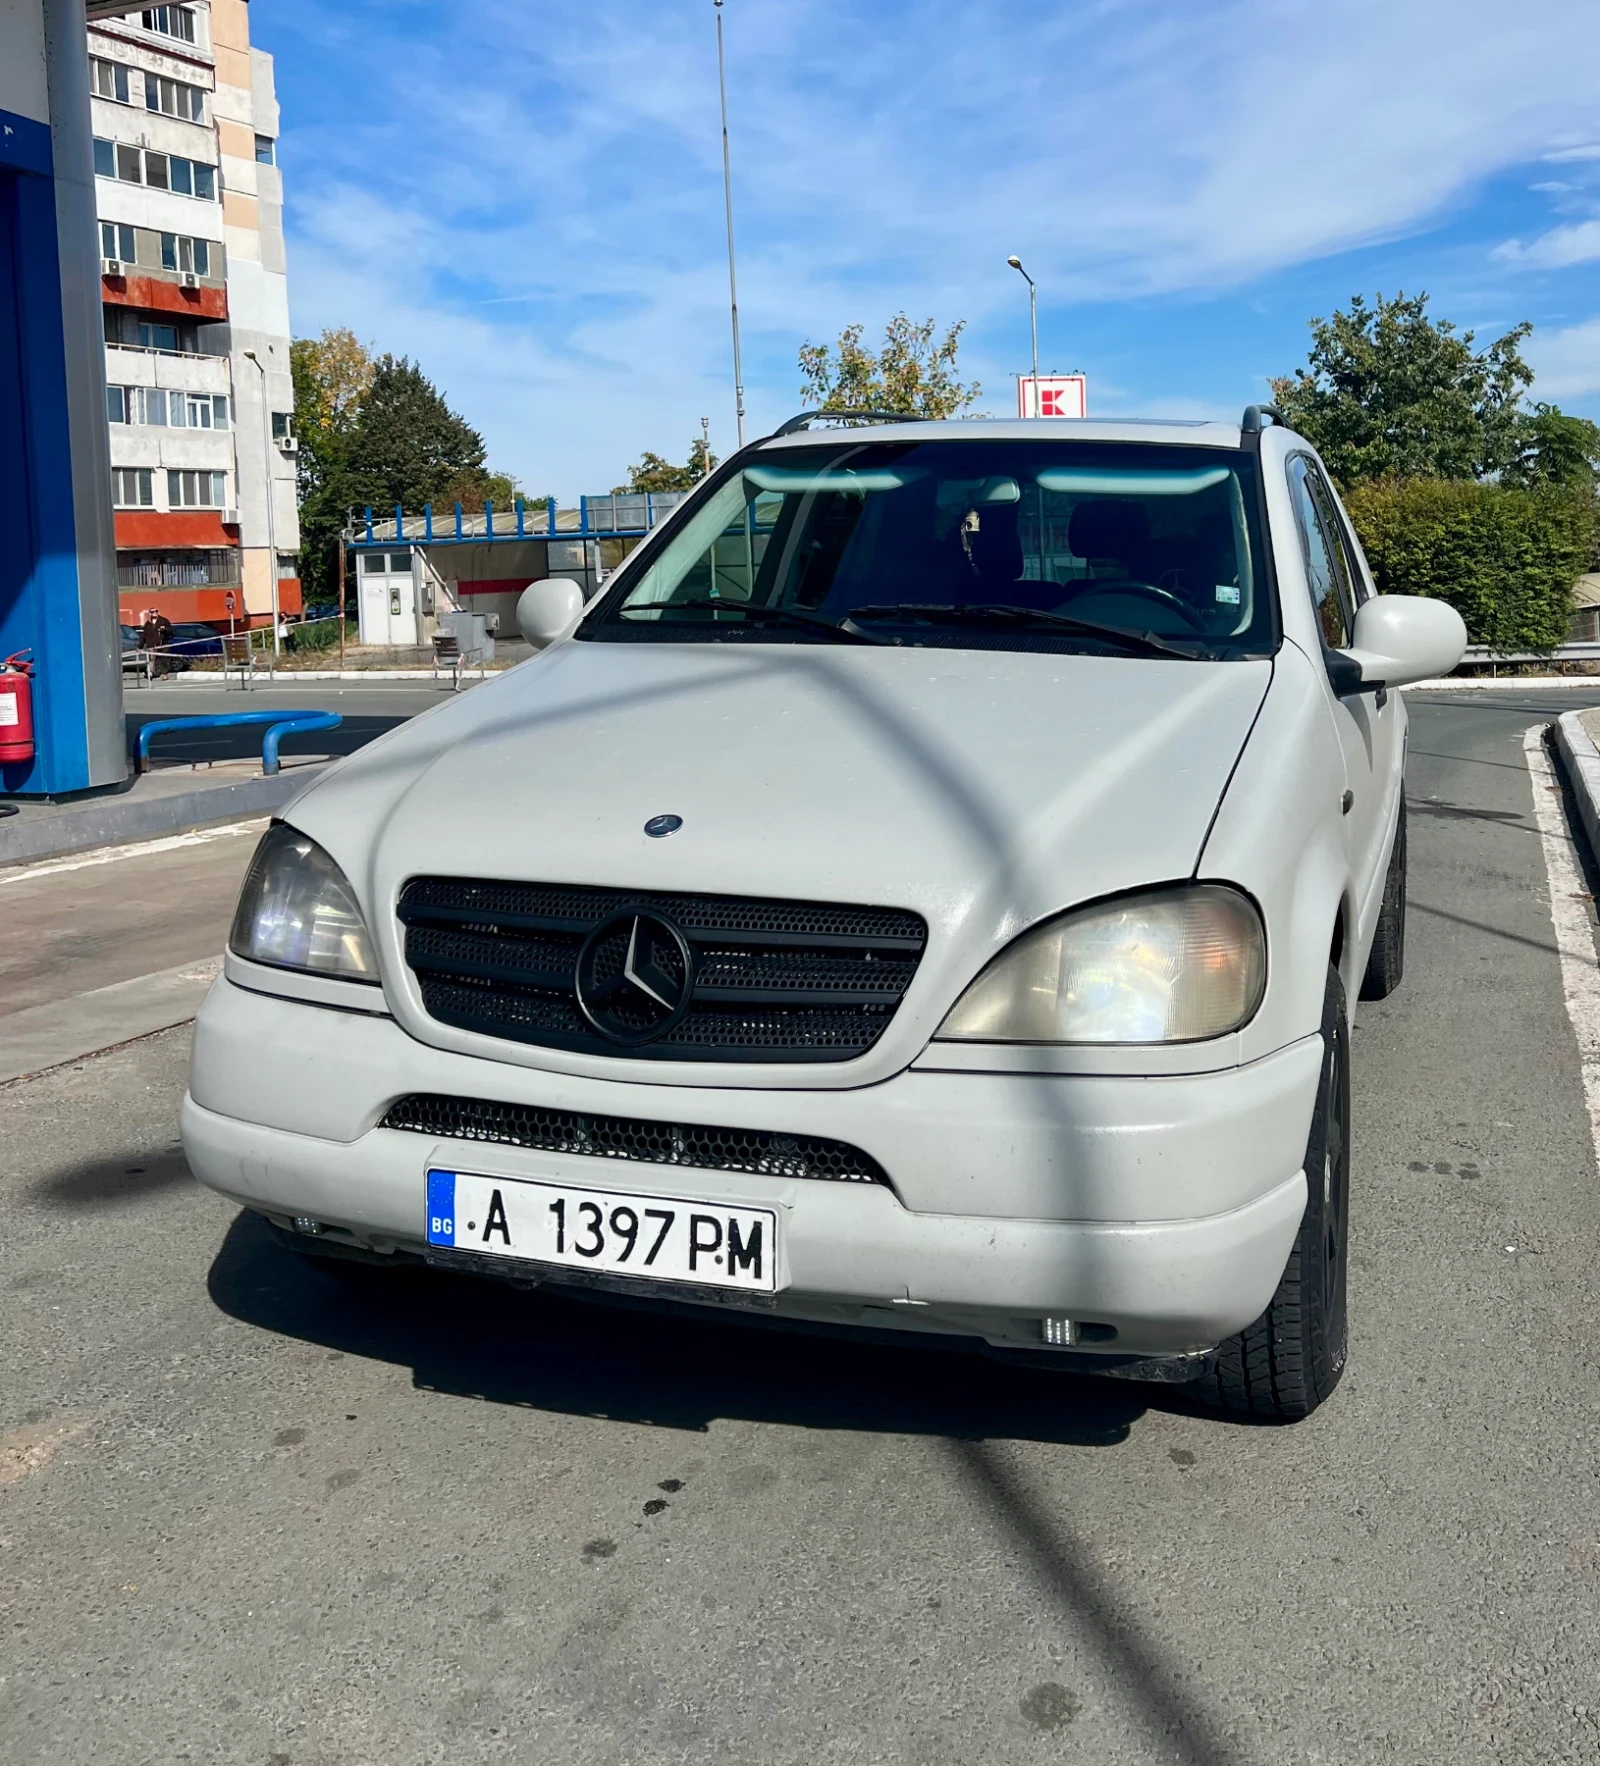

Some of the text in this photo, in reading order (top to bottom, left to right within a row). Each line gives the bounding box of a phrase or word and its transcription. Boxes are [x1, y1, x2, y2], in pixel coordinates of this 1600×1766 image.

[1042, 390, 1066, 415] K
[431, 1217, 453, 1235] BG
[482, 1189, 762, 1279] A 1397 PM
